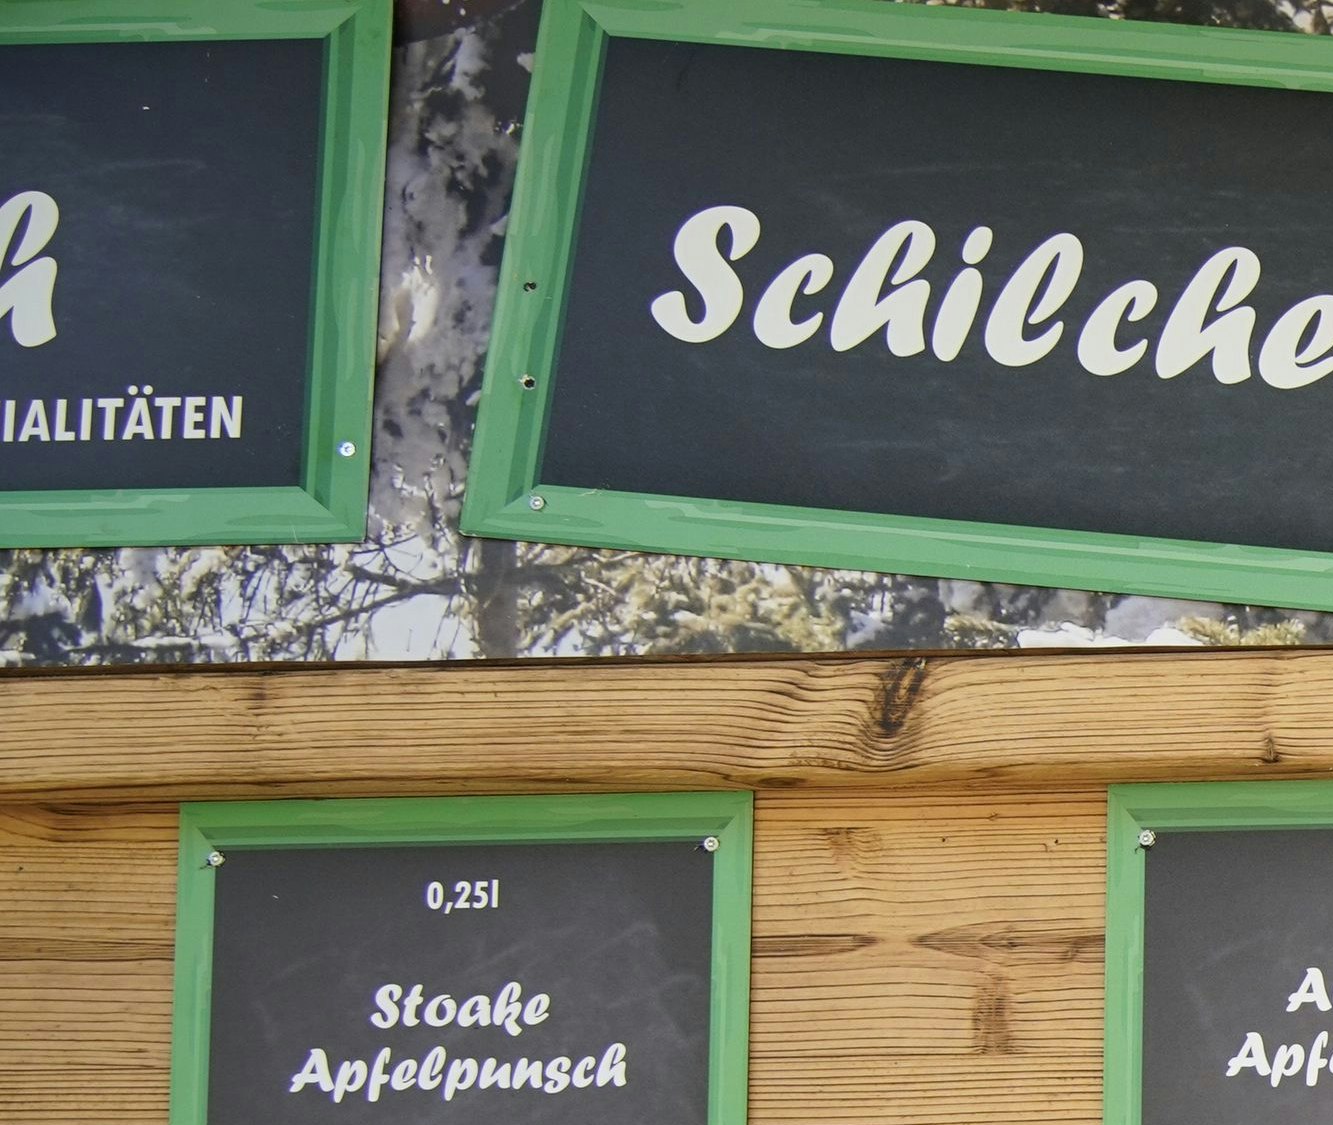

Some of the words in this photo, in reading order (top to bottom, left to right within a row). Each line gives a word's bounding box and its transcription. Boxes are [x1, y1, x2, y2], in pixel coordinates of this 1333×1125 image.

[0, 385, 243, 442] IALITÄTEN
[426, 879, 499, 915] 0,25l
[370, 981, 550, 1037] Stoake
[289, 1042, 627, 1104] Apfelpunsch
